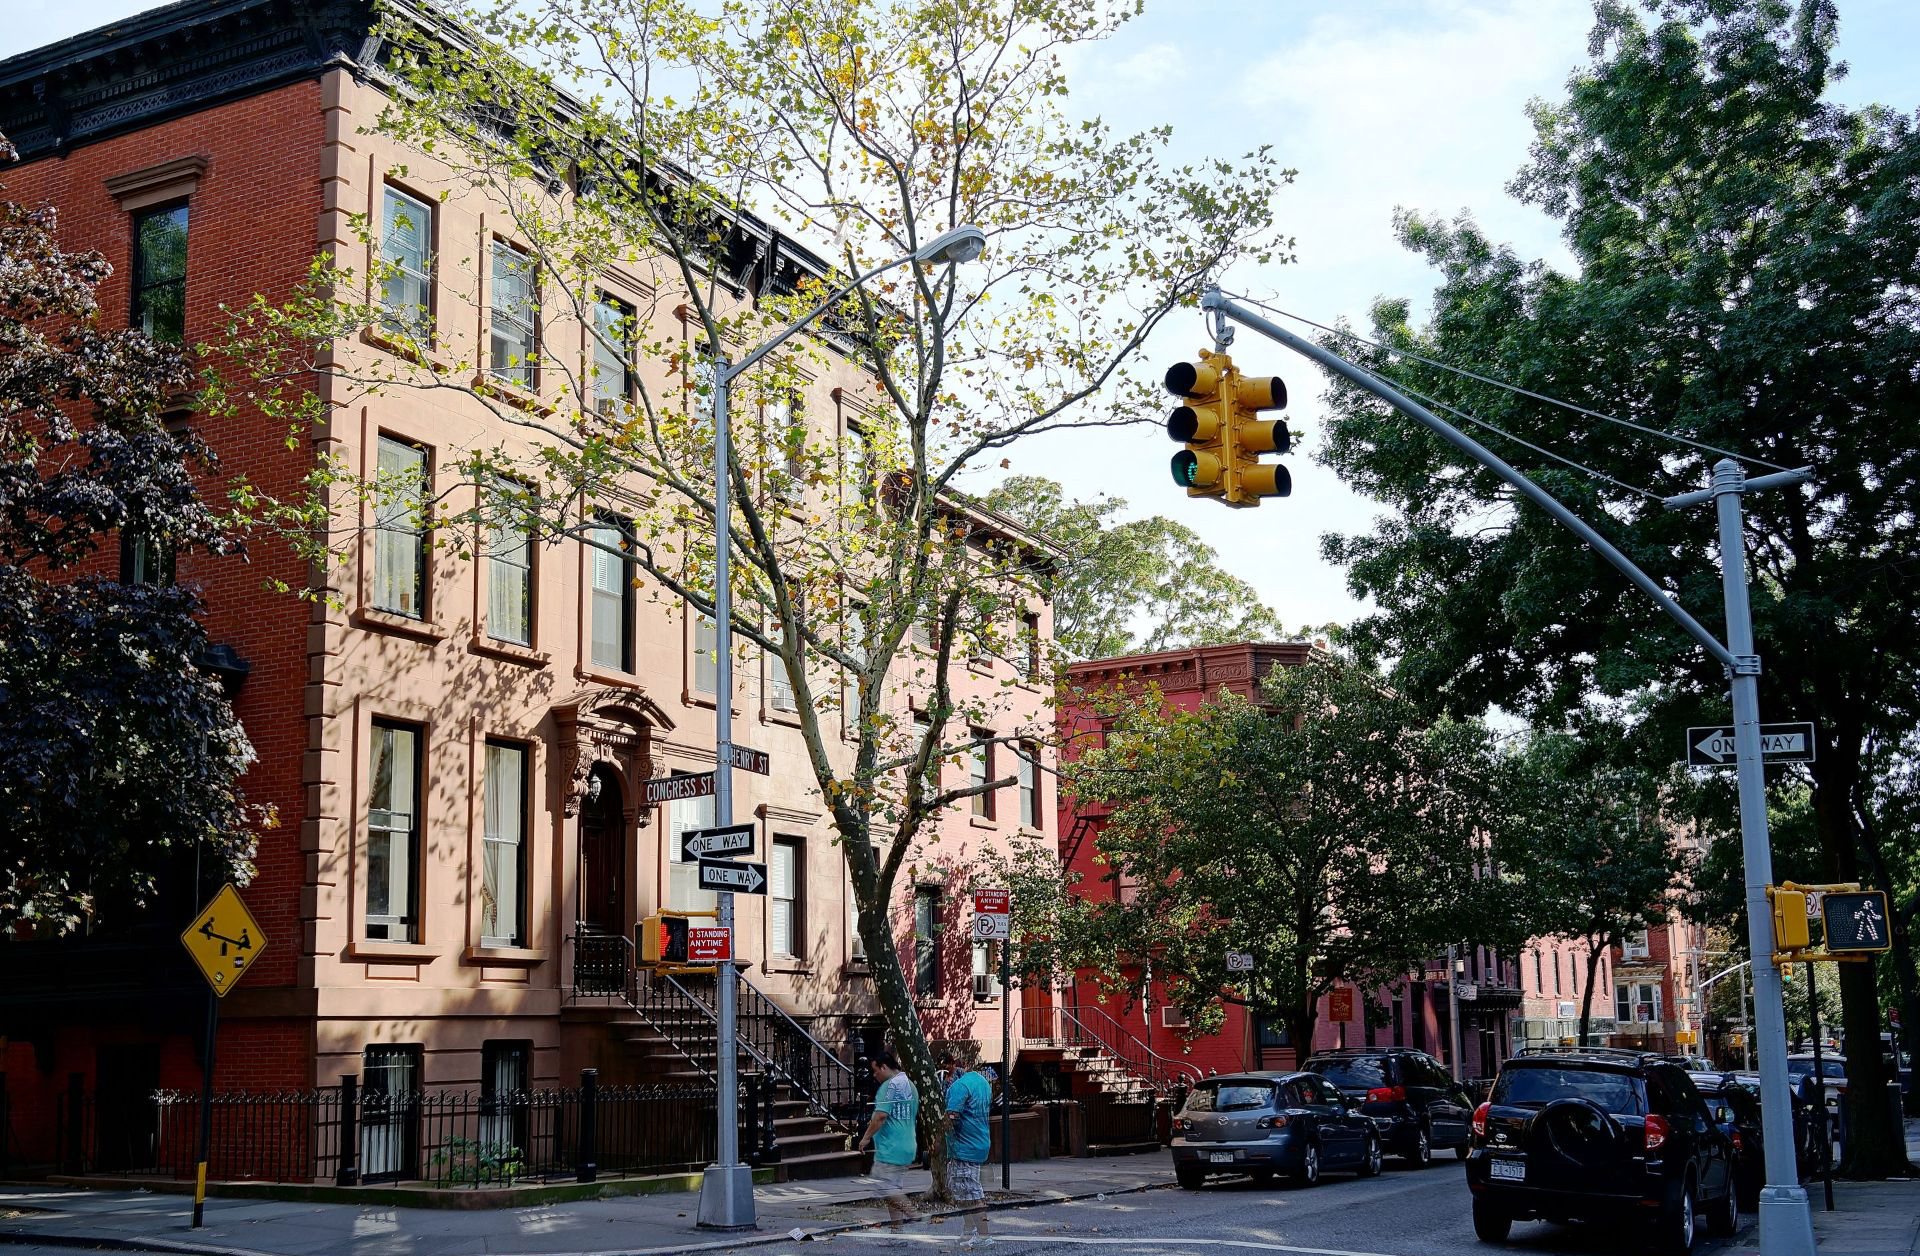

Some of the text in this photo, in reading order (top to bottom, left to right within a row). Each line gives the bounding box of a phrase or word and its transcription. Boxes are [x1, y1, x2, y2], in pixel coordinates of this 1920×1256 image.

[1711, 738, 1735, 753] ON
[731, 748, 768, 774] HENRY ST
[646, 775, 712, 801] CONGRESS ST
[692, 834, 745, 852] ONE WAY
[708, 868, 757, 885] ONE WAY
[696, 930, 728, 938] STANDING
[690, 939, 723, 947] ANYTIME
